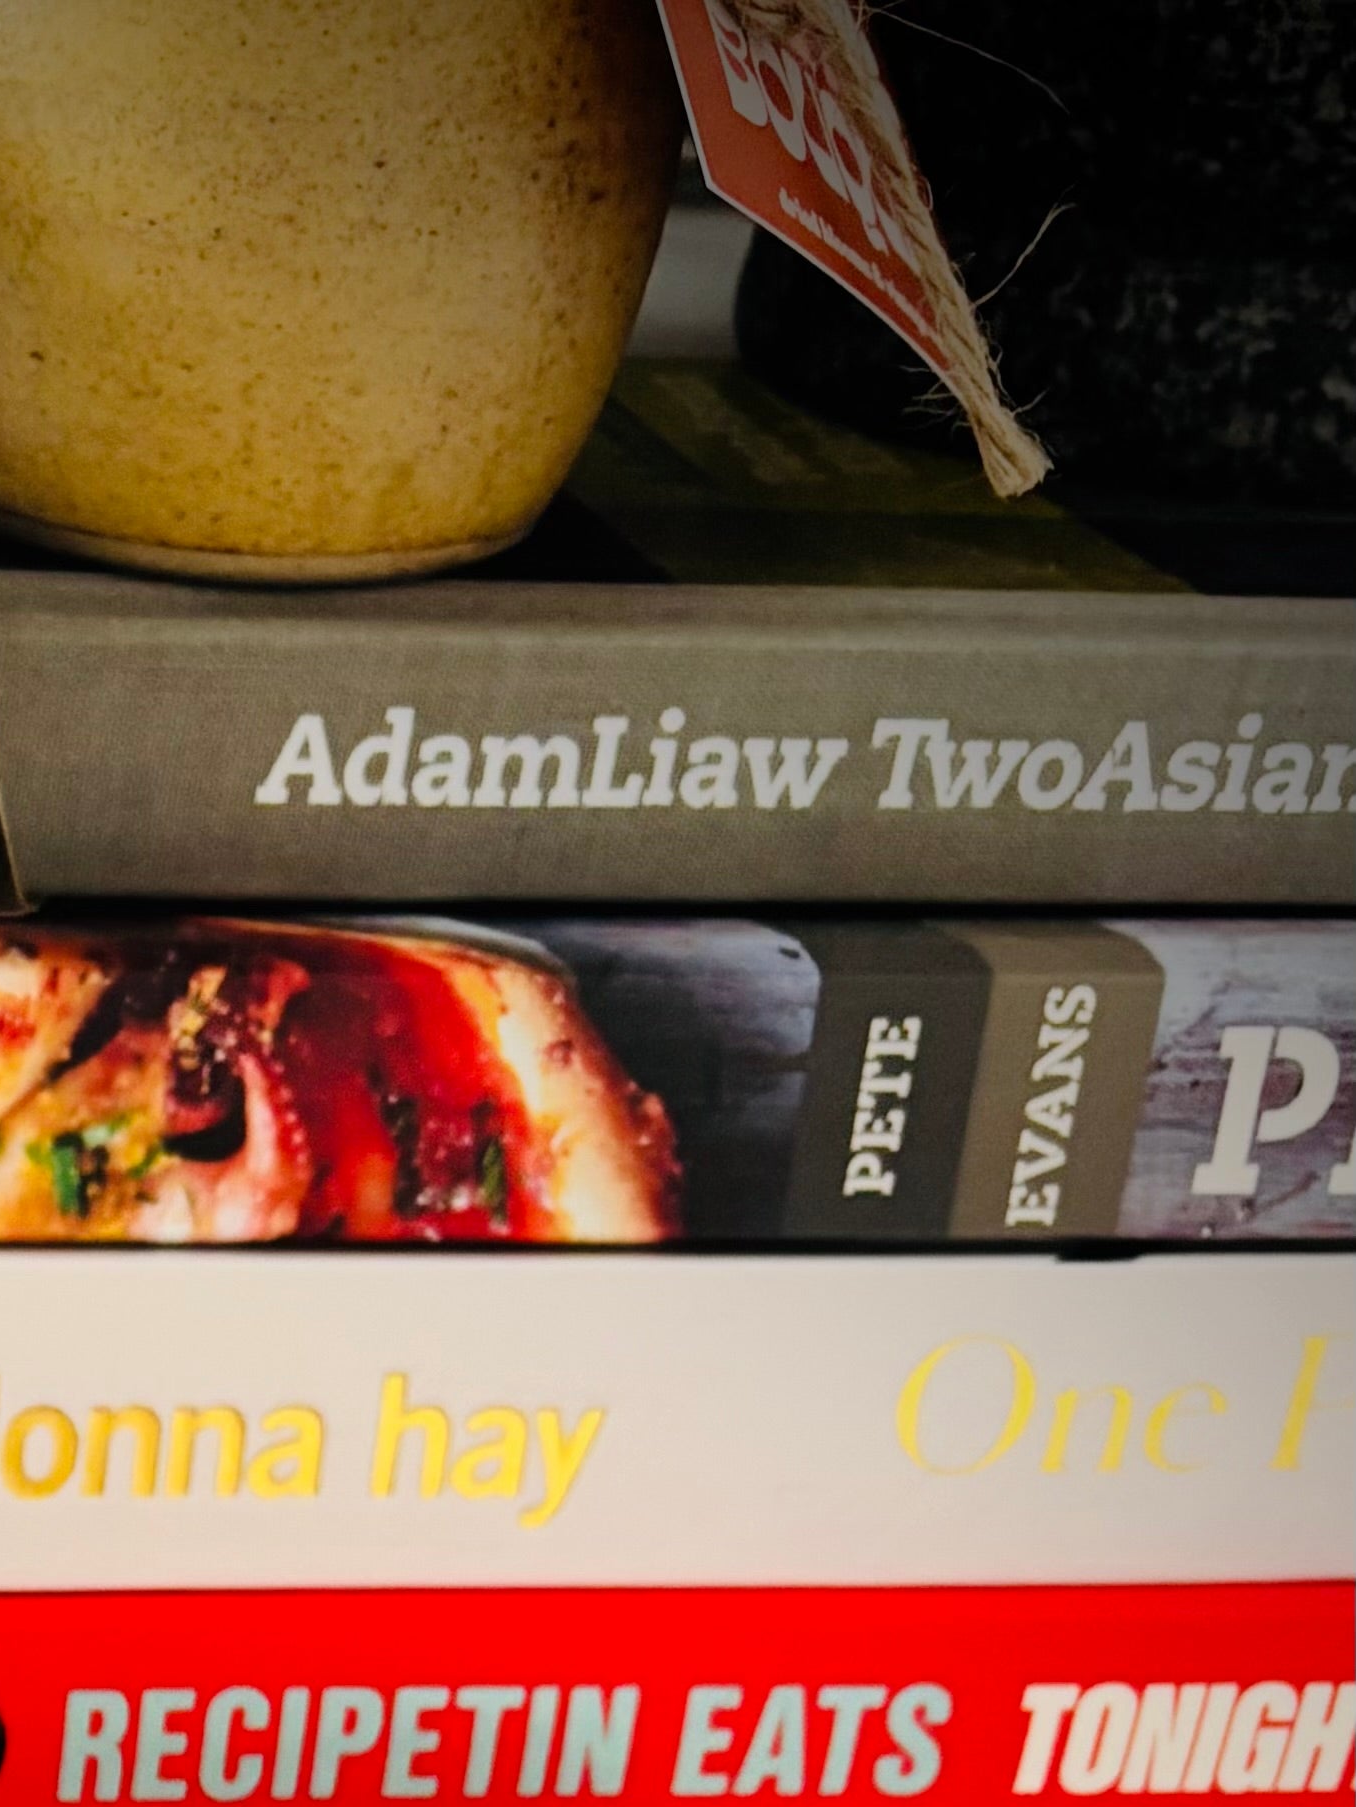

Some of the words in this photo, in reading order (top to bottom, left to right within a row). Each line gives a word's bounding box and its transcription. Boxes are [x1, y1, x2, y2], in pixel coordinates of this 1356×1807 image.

[843, 1015, 923, 1197] PETE
[1005, 984, 1097, 1228] EVANS
[1192, 1025, 1356, 1195] P
[370, 1373, 605, 1525] hay
[894, 1332, 1229, 1476] One
[56, 1685, 640, 1803] RECIPETIN
[670, 1682, 953, 1799] EATS
[1011, 1681, 1356, 1796] TONIGH
